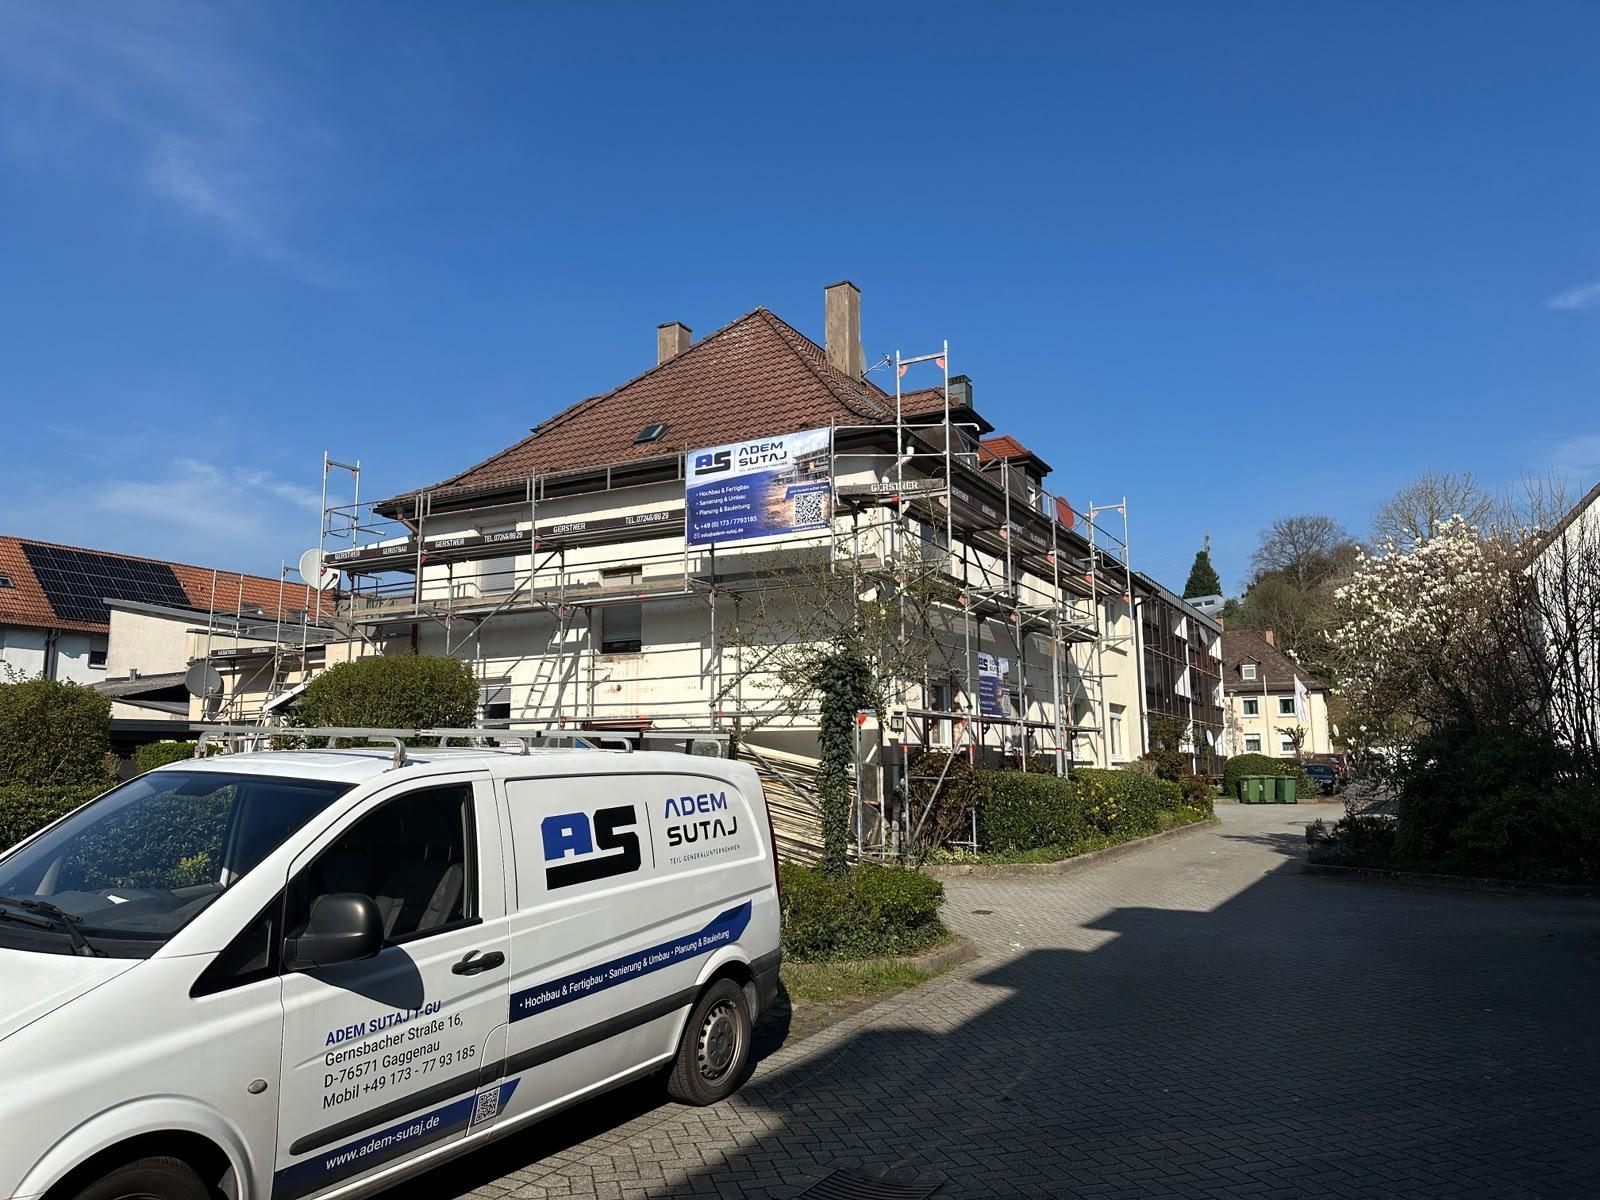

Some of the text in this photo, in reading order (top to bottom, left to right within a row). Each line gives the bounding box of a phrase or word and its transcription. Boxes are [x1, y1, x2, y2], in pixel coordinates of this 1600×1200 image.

[739, 441, 784, 456] ADEM
[739, 451, 787, 466] SUTAJ
[695, 450, 731, 475] AS
[726, 484, 750, 492] Fertigbau
[871, 481, 918, 492] GERSTNER
[699, 498, 723, 506] Sanierung
[553, 522, 586, 533] GERSTNER
[733, 516, 758, 524] 7793185
[435, 538, 465, 548] GERSTNER
[664, 791, 728, 819] ADEM
[667, 816, 739, 847] SUTAJ
[541, 805, 641, 890] AS
[524, 930, 730, 1009] Hochbau & Fertigbau Sanierung & Umbau Planung & Bauleitung
[325, 1022, 365, 1046] ADEM
[369, 1008, 410, 1032] SUTAJ
[325, 1013, 463, 1067] Gernsbacher Straße 16,
[322, 1083, 360, 1110] Mobil
[362, 1076, 386, 1093] +49
[390, 1067, 411, 1085] 173
[422, 1058, 436, 1074] 77
[439, 1053, 452, 1068] 93
[456, 1045, 475, 1061] 185
[324, 1041, 440, 1088] D-76571 Gaggenau
[325, 1115, 440, 1170] www.adem-sutaj.de
